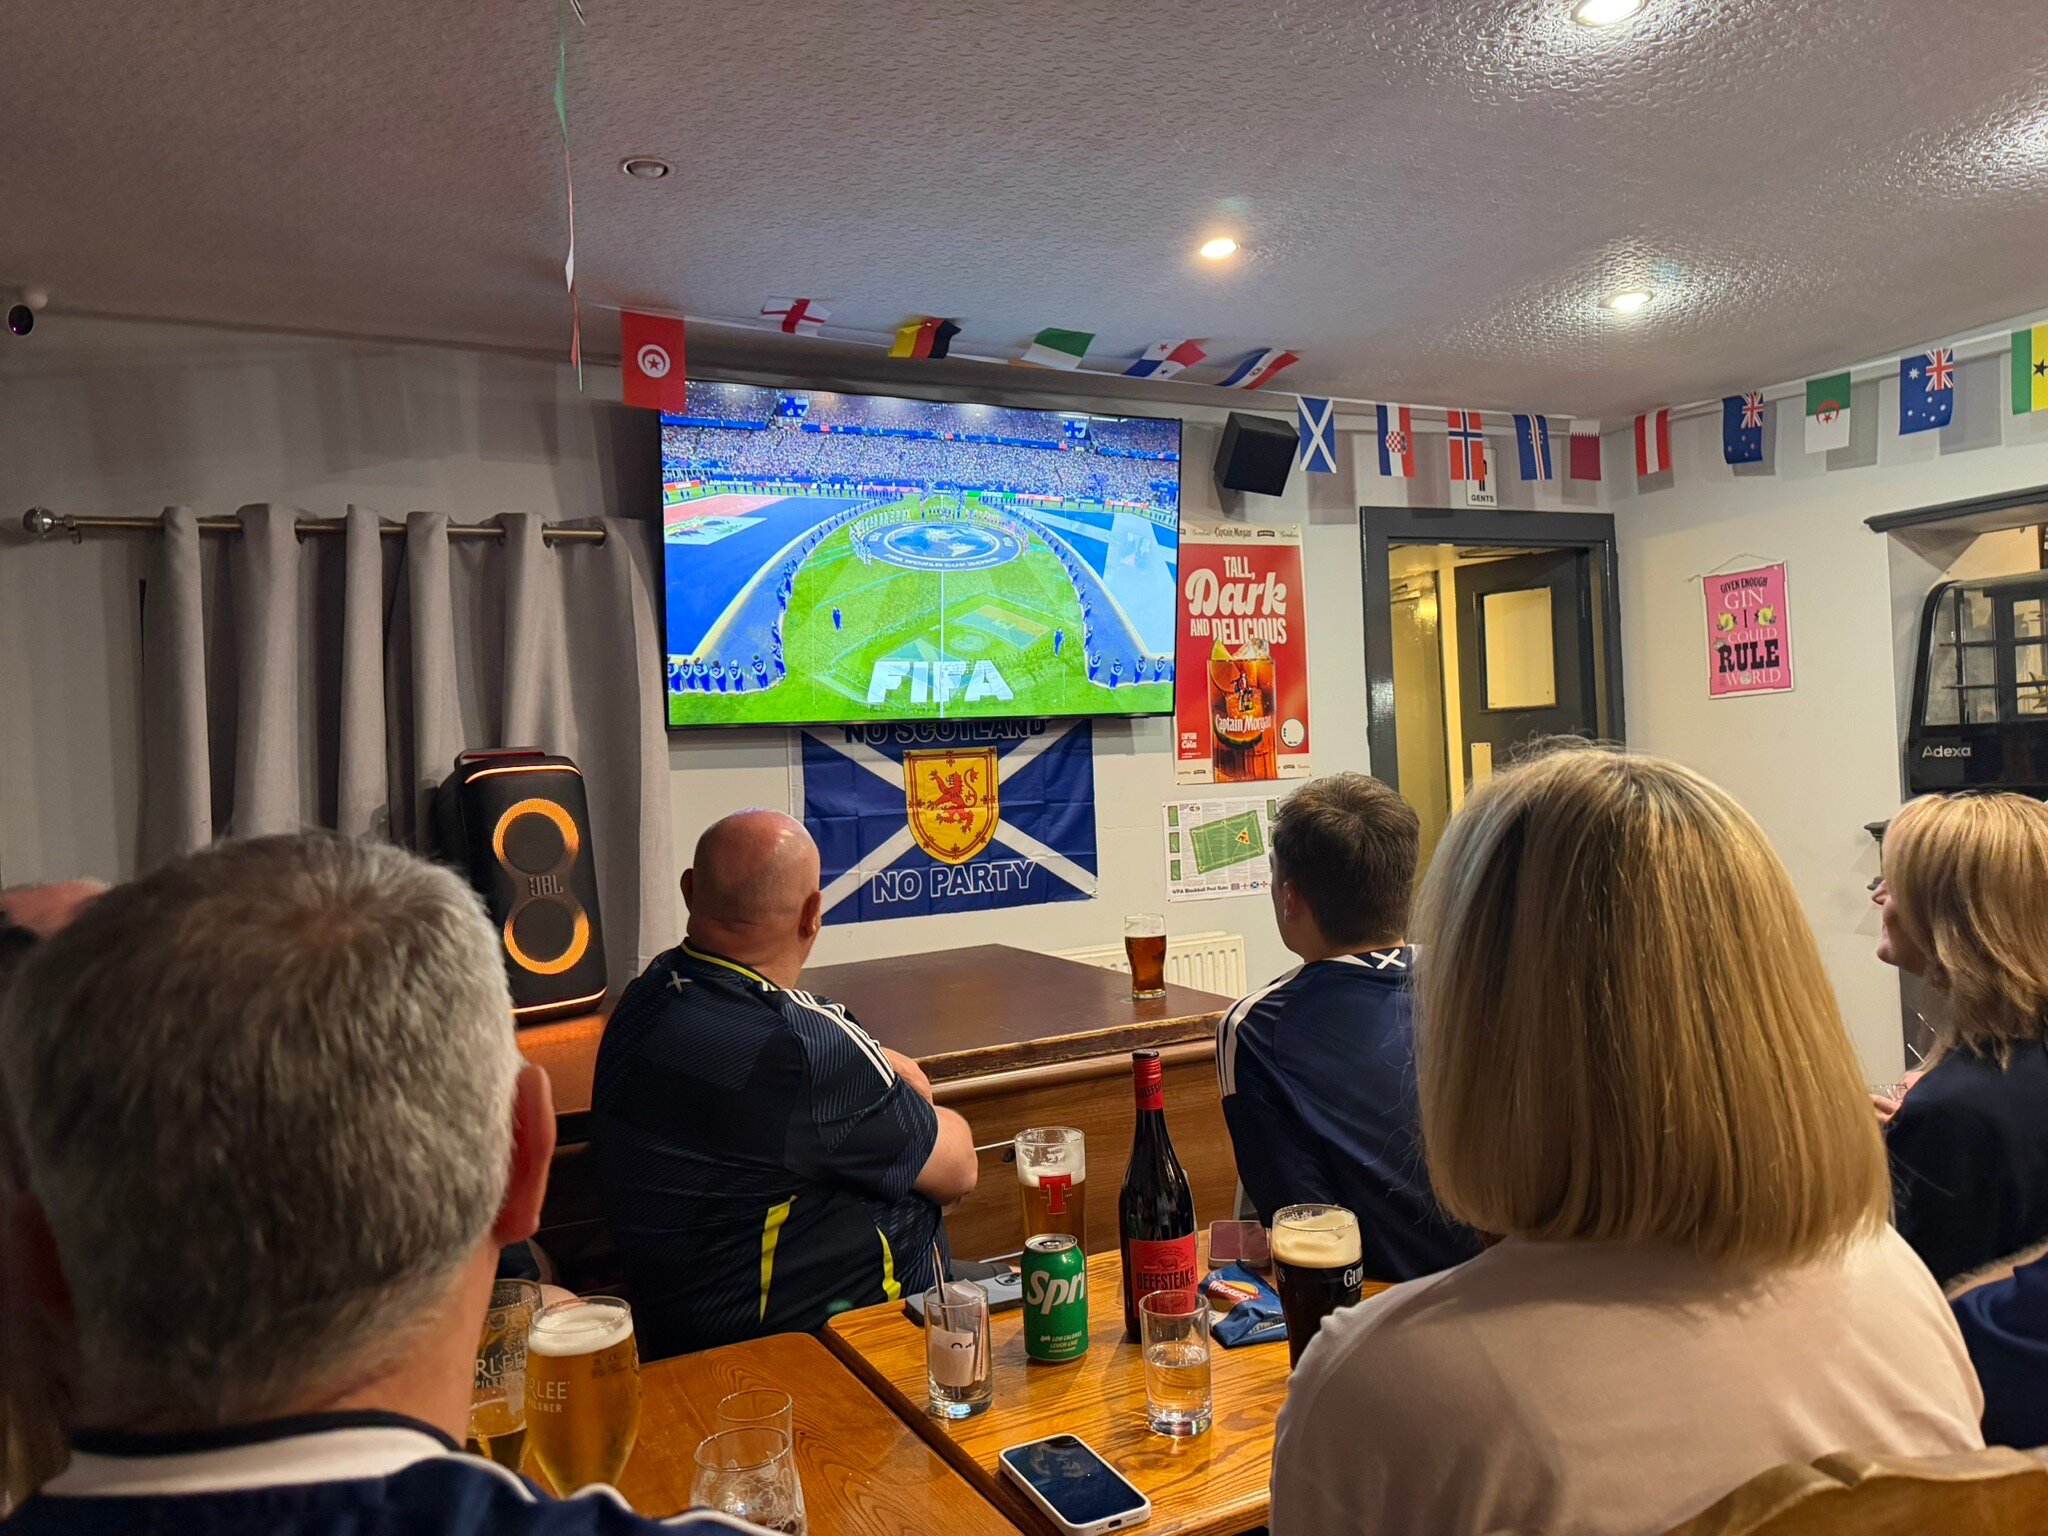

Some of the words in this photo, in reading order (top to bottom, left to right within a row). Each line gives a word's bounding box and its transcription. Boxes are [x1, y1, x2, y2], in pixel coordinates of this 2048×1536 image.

[1471, 494, 1495, 503] GENTS
[1223, 556, 1256, 580] TALL,
[1184, 568, 1287, 616] Dark
[1720, 579, 1740, 593] GIVEN
[1741, 577, 1768, 589] ENOUGH
[1724, 588, 1764, 610] GIN
[1743, 609, 1748, 628] I
[1190, 618, 1210, 636] AND
[1211, 617, 1287, 645] DELICIOUS
[1728, 627, 1778, 643] COULD
[1719, 639, 1780, 673] RULE
[867, 660, 1014, 703] FIFA
[1725, 669, 1781, 686] WORLD
[844, 723, 889, 745] NO
[896, 718, 1047, 744] SCOTLAND
[1215, 714, 1243, 734] Captain
[1242, 715, 1271, 733] Morgan
[1922, 745, 1971, 758] Adexa
[529, 874, 564, 897] JBL
[872, 869, 922, 903] NO
[930, 860, 1036, 898] PARTY
[1038, 1172, 1072, 1215] T
[1136, 1270, 1191, 1291] BEEFSTEAK
[475, 1352, 526, 1379] RLEE
